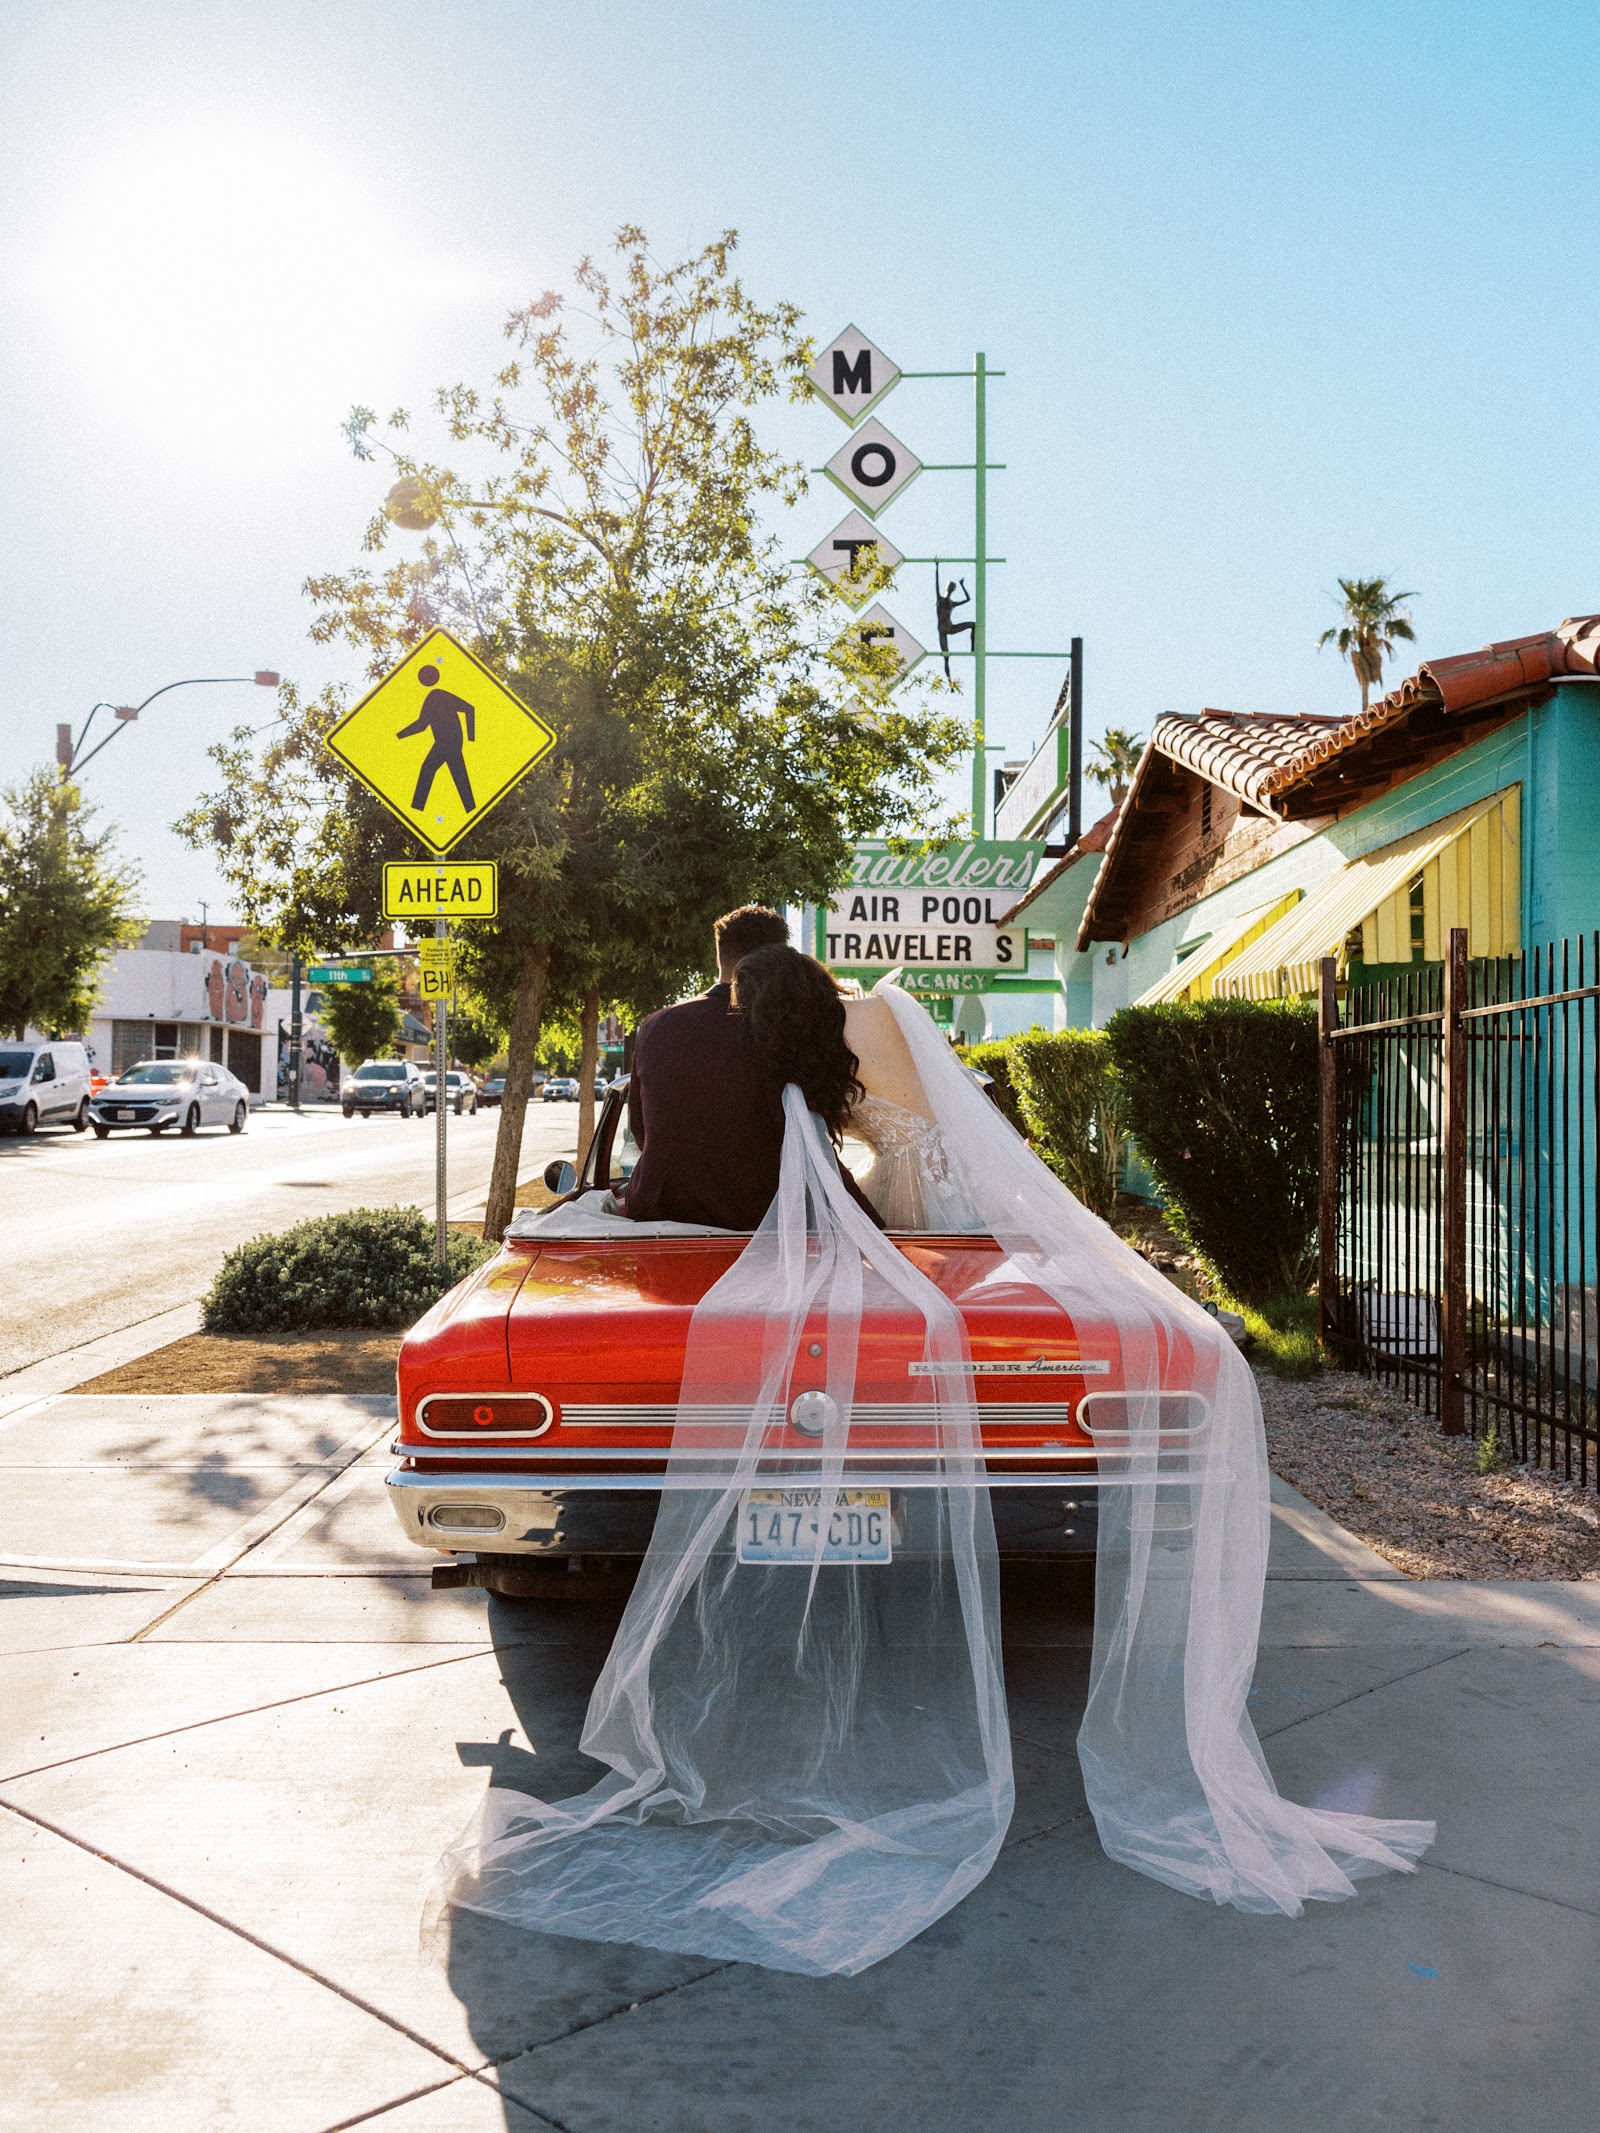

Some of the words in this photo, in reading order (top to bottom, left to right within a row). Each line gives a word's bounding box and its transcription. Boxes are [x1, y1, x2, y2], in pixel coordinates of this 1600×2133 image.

[398, 877, 483, 903] AHEAD
[849, 895, 900, 922] AIR
[922, 896, 1000, 925] POOL
[826, 933, 972, 962] TRAVELER
[995, 935, 1013, 962] S
[329, 970, 348, 981] 11th
[1026, 1355, 1103, 1373] American
[748, 1512, 803, 1547] 147
